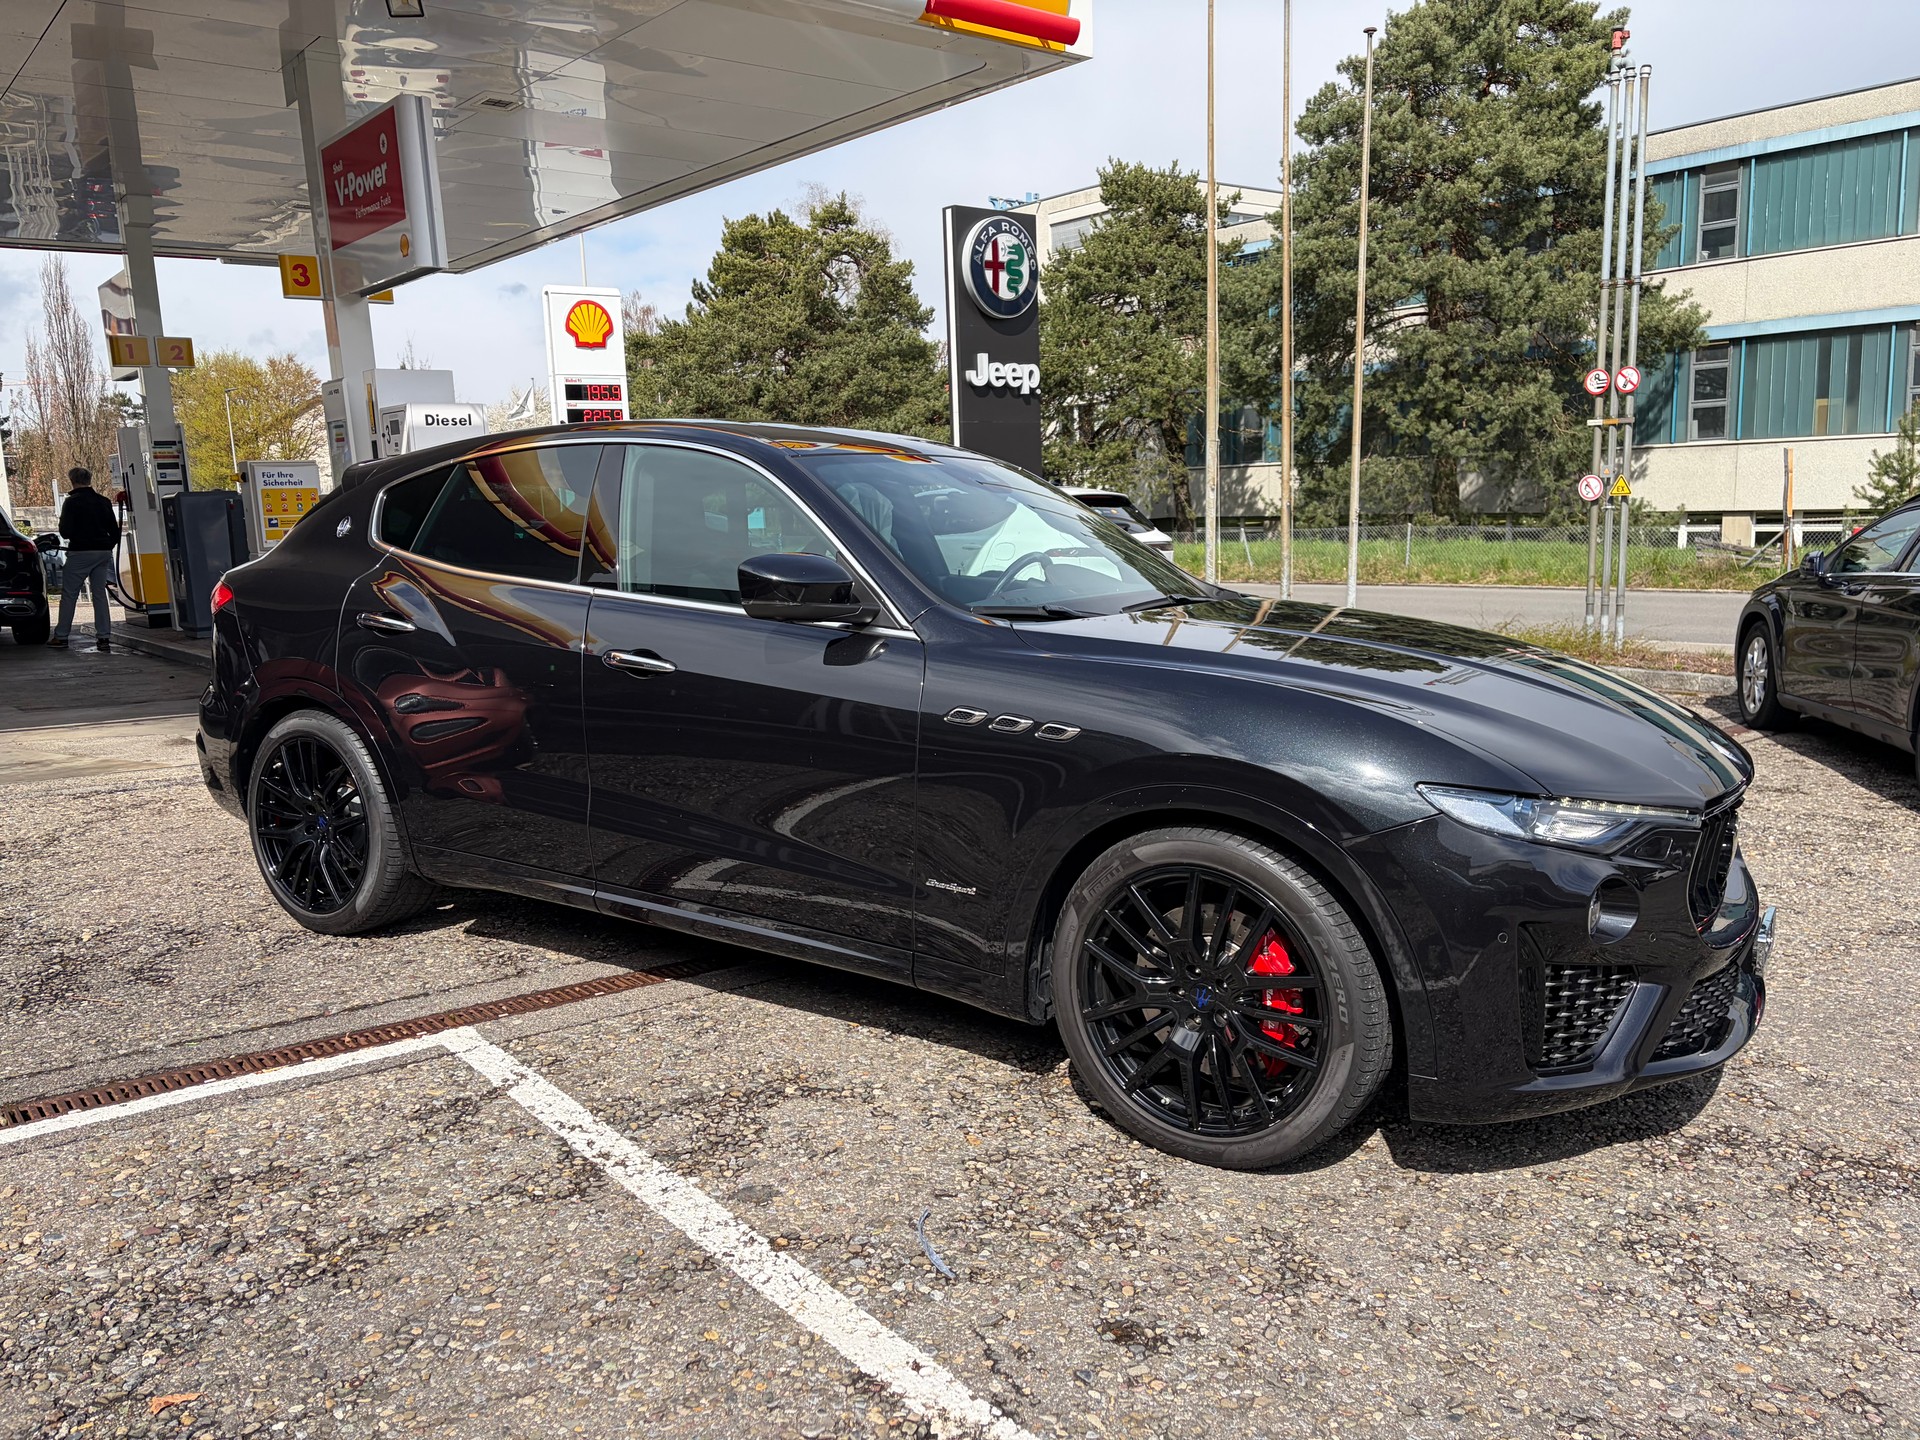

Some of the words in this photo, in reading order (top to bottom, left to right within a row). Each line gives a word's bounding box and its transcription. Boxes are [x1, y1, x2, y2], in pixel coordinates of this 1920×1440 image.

[332, 160, 343, 175] Shell
[334, 162, 388, 206] V-Power
[355, 202, 380, 220] Performance
[380, 193, 392, 208] Fuels
[973, 226, 998, 266] ALFA
[1001, 222, 1037, 272] ROMEO
[292, 263, 311, 288] 3
[125, 343, 135, 360] 1
[170, 344, 184, 361] 2
[587, 384, 621, 401] 195.9
[424, 413, 472, 426] Diesel
[386, 425, 391, 445] 3
[129, 463, 135, 475] 1
[277, 471, 293, 479] Ihre
[263, 479, 303, 487] Sicherheit
